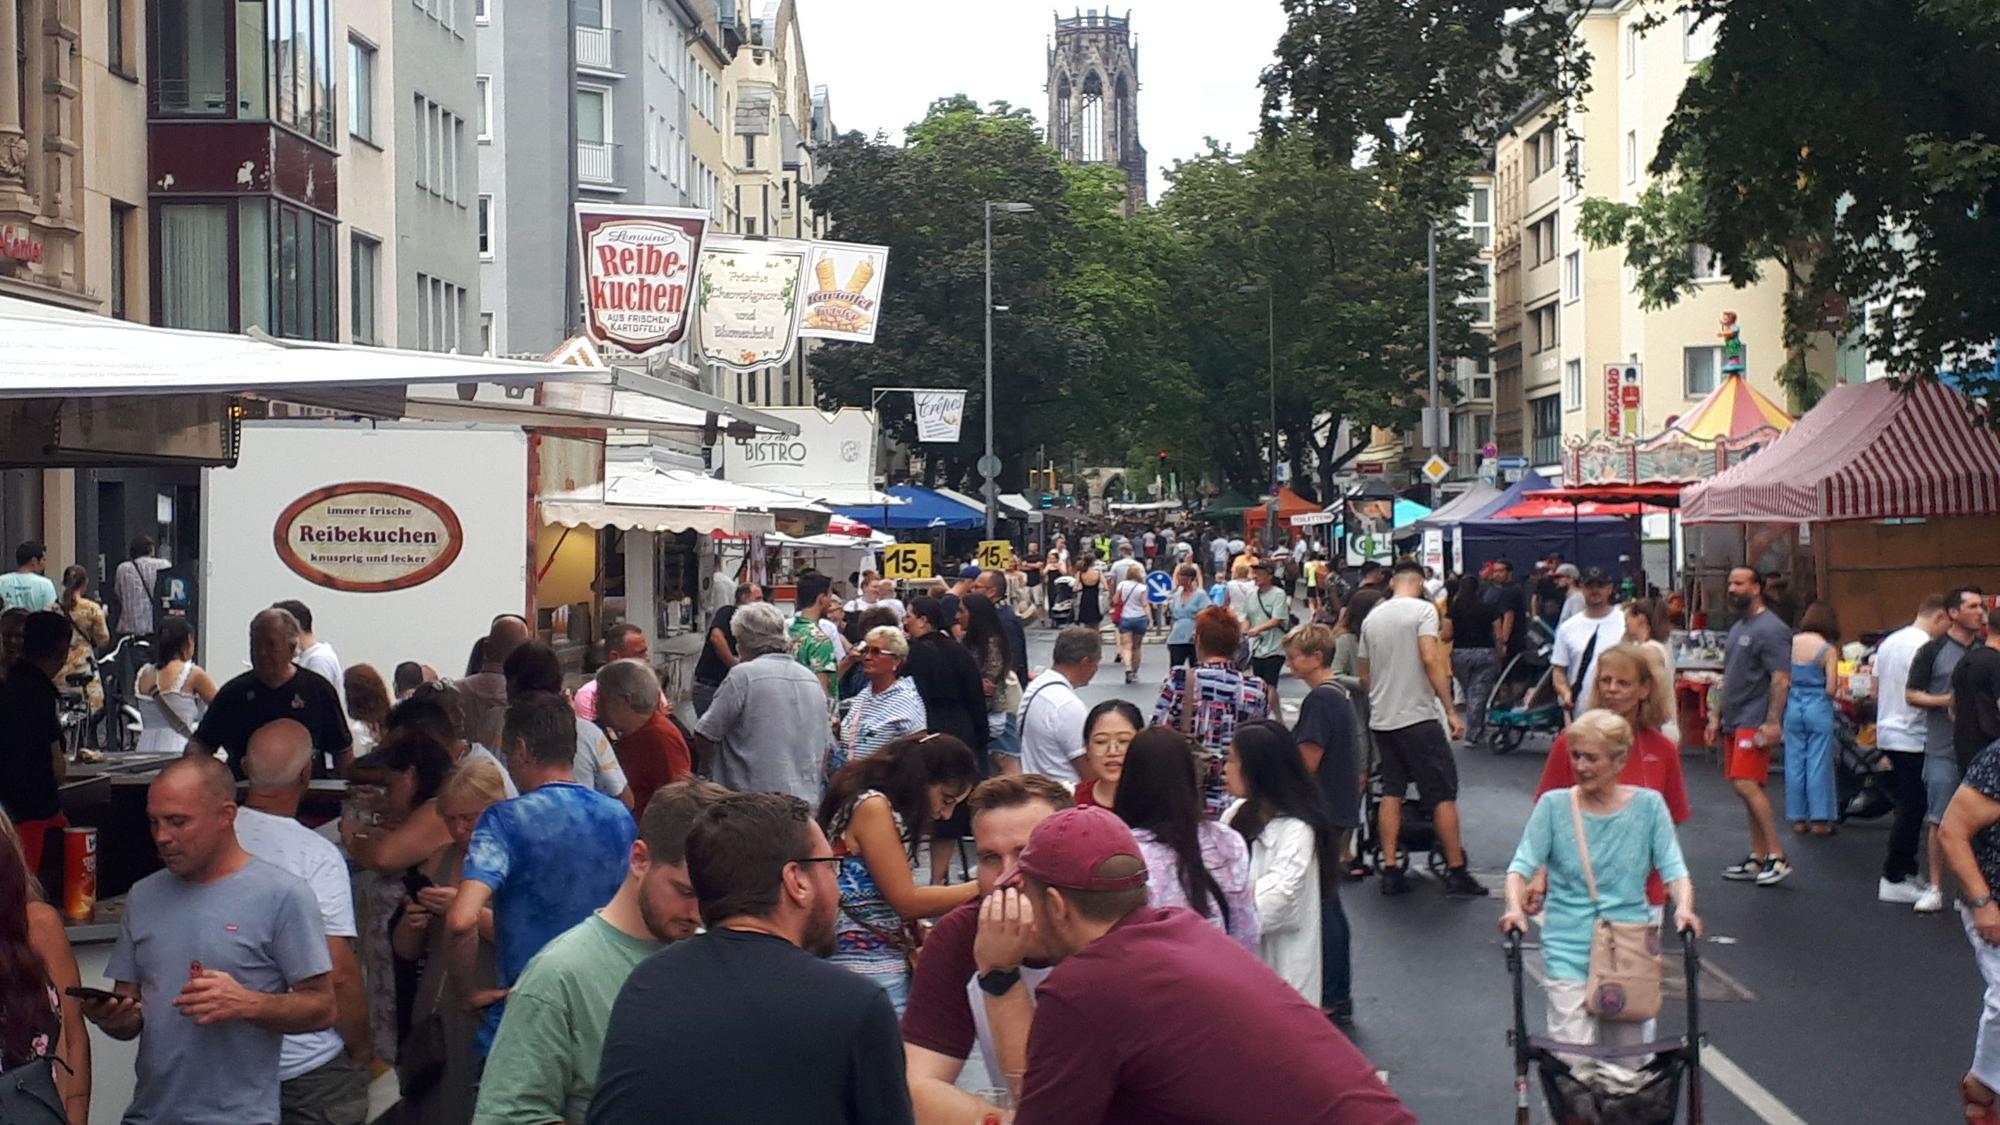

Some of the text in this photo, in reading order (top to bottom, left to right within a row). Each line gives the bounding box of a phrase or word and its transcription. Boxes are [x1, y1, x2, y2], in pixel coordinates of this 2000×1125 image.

[596, 243, 687, 278] Reibe-
[592, 275, 684, 313] kuchen
[607, 313, 670, 324] AUS FRISCHEN
[610, 322, 665, 333] KARTOFFELN
[745, 442, 807, 462] BISTRO
[327, 506, 412, 516] immer frische
[300, 525, 437, 544] Reibekuchen
[310, 553, 426, 564] knusprig und lecker
[886, 549, 929, 578] 15,-
